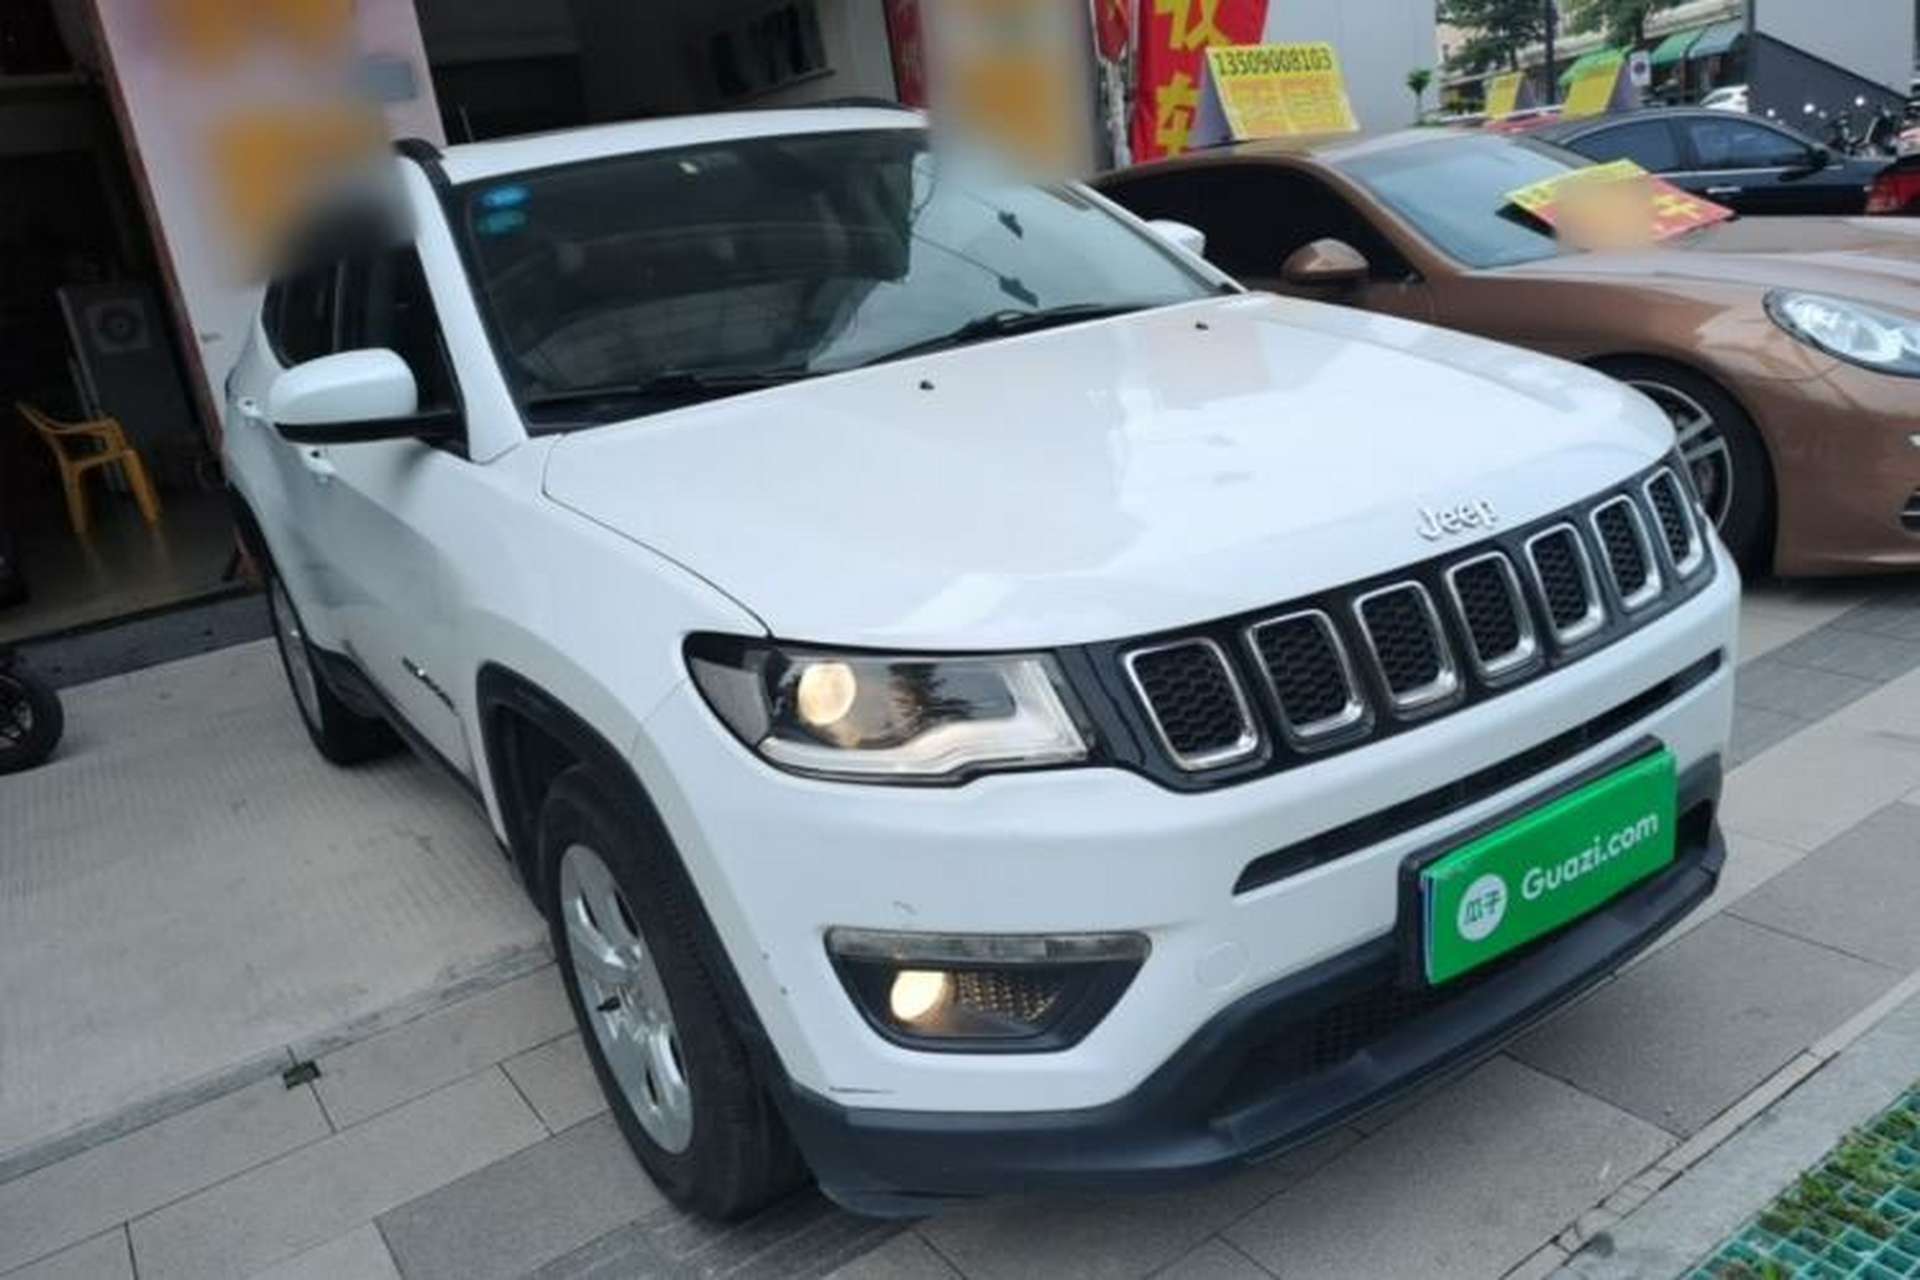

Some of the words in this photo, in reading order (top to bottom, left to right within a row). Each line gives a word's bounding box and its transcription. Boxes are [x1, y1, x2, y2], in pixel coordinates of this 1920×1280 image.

[1417, 498, 1497, 541] Jeep
[1521, 813, 1659, 900] Guazi.com
[1463, 889, 1501, 926] 瓜子
